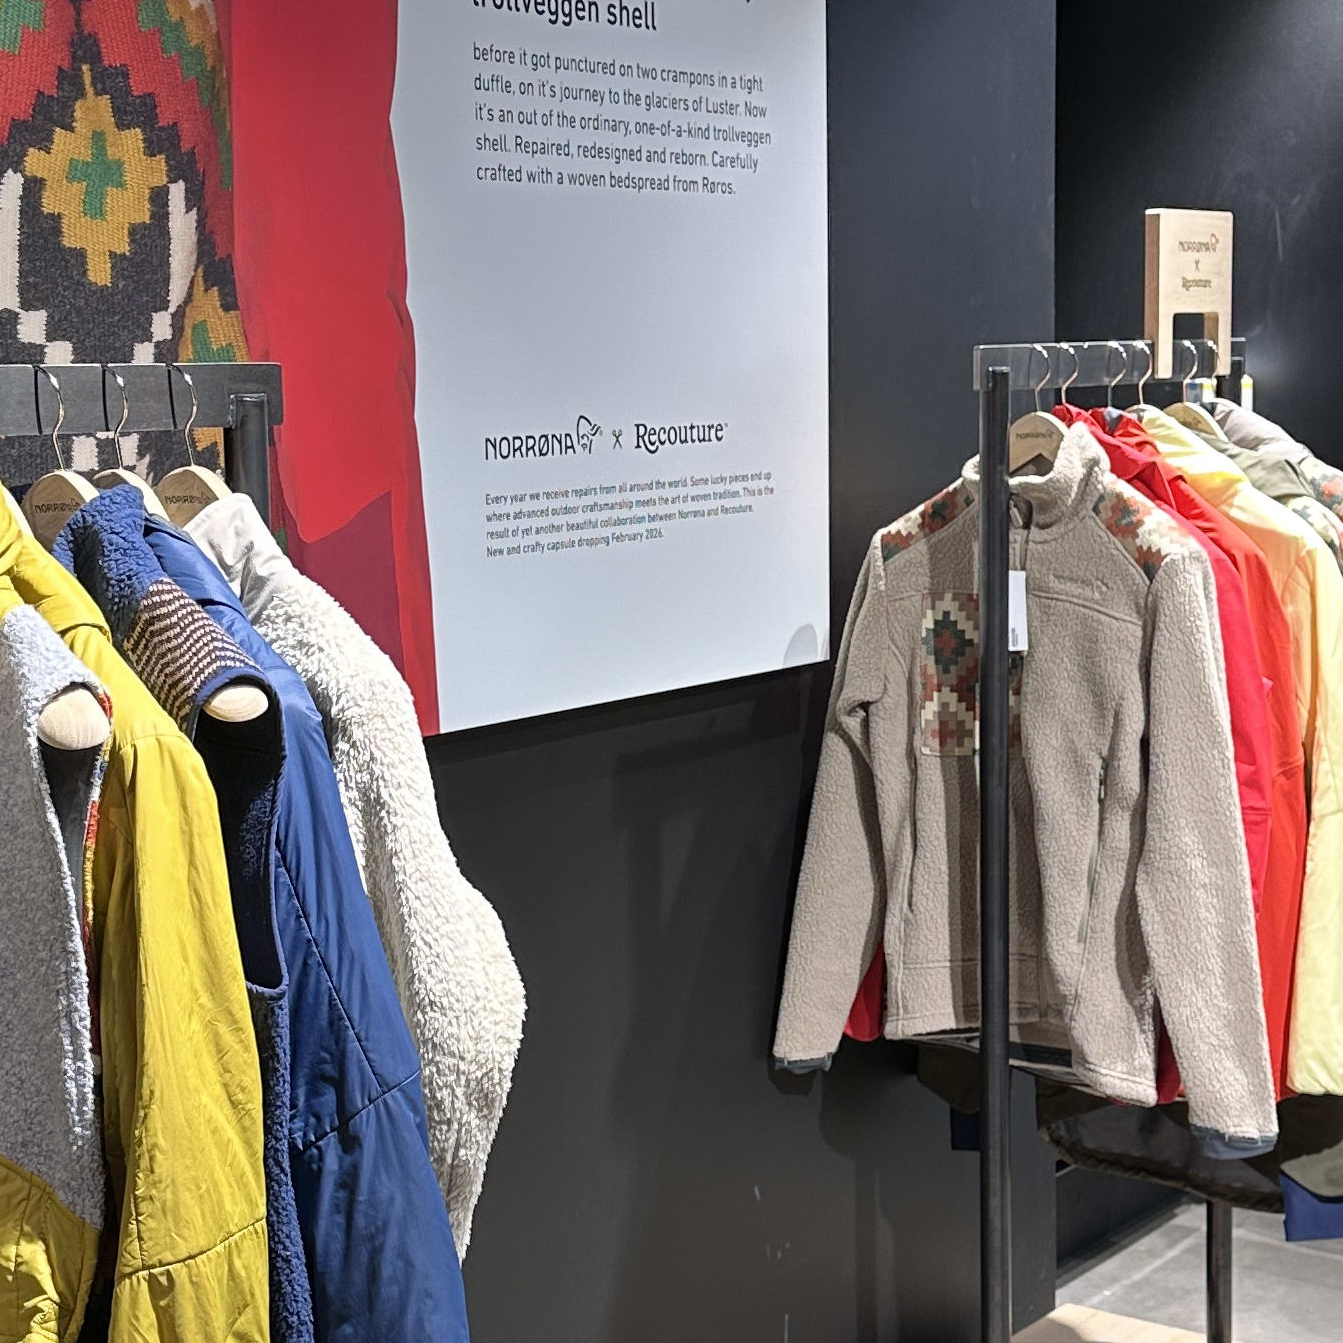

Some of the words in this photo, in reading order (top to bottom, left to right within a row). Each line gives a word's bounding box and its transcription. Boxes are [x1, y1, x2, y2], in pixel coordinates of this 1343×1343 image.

[473, 41, 515, 64] before
[519, 47, 527, 66] it
[531, 52, 551, 71] got
[555, 56, 615, 75] punctured
[619, 63, 633, 77] on
[637, 63, 657, 81] two
[661, 69, 715, 88] crampons
[717, 71, 727, 88] in
[730, 77, 737, 89] a
[739, 73, 763, 94] tight
[474, 73, 515, 96] duffle,
[519, 81, 535, 97] on
[538, 79, 556, 98] it's
[559, 81, 605, 107] journey
[609, 87, 619, 105] to
[623, 89, 641, 106] the
[645, 91, 689, 111] glaciers
[692, 95, 703, 112] of
[706, 97, 743, 117] Luster.
[745, 100, 767, 118] Now
[498, 110, 513, 124] an
[517, 109, 537, 125] out
[541, 109, 553, 127] of
[557, 111, 577, 129] the
[579, 113, 631, 137] ordinary,
[635, 120, 710, 141] one-of-a-kind
[713, 125, 771, 148] trollveggen
[475, 133, 511, 153] shell.
[515, 135, 574, 159] Repaired,
[577, 141, 642, 165] redesigned
[646, 147, 666, 163] and
[669, 149, 709, 166] reborn.
[712, 151, 758, 173] Carefully
[476, 163, 523, 182] crafted
[527, 166, 553, 185] with
[557, 172, 563, 185] a
[567, 173, 606, 187] woven
[609, 171, 669, 193] bedspread
[673, 175, 699, 193] from
[702, 177, 737, 195] Røros.
[485, 433, 576, 461] NORRØNA
[485, 493, 507, 505] Every
[510, 493, 527, 505] year
[529, 491, 540, 501] we
[543, 489, 569, 501] receive
[571, 486, 597, 499] repairs
[599, 485, 617, 495] from
[618, 482, 627, 493] all
[629, 480, 653, 493] around
[655, 479, 665, 489] the
[690, 476, 709, 487] Some
[729, 473, 749, 485] pieces
[763, 472, 771, 481] up
[486, 511, 511, 523] where
[513, 507, 549, 521] advanced
[551, 505, 579, 516] outdoor
[581, 499, 633, 513] craftsmanship
[635, 497, 657, 508] meets
[658, 495, 669, 505] the
[671, 495, 681, 505] art
[681, 493, 689, 503] of
[691, 492, 711, 502] woven
[743, 487, 755, 497] This
[757, 486, 763, 496] is
[763, 485, 774, 495] the
[487, 529, 509, 541] result
[511, 527, 519, 537] of
[521, 526, 533, 539] yet
[535, 523, 563, 535] another
[566, 519, 599, 532] beautiful
[600, 513, 646, 528] collaboration
[647, 509, 676, 523] between
[707, 506, 719, 517] and
[487, 546, 504, 557] New
[507, 545, 521, 555] and
[523, 541, 545, 554] crafty
[547, 539, 575, 551] capsule
[577, 535, 609, 548] dropping
[611, 531, 643, 543] February
